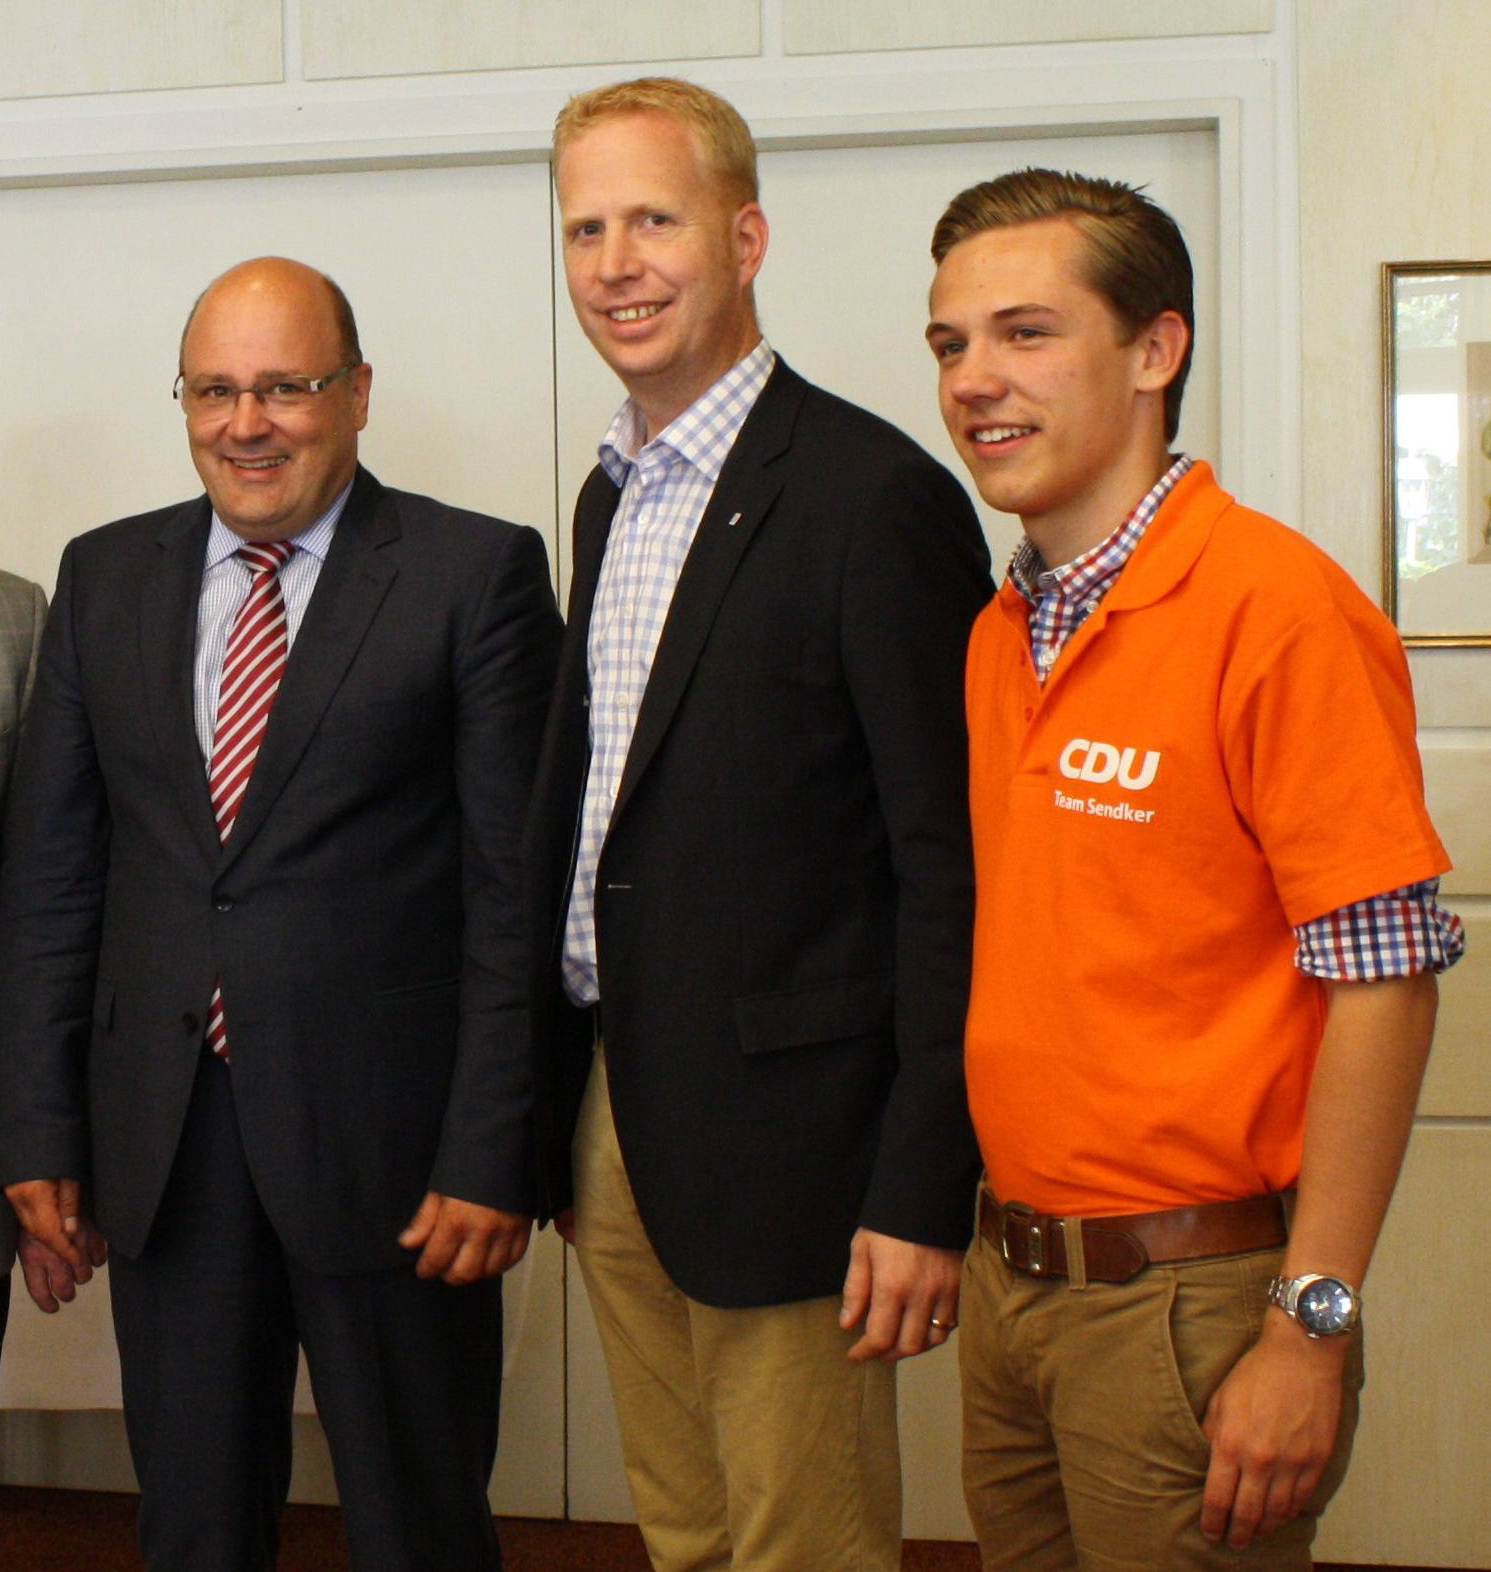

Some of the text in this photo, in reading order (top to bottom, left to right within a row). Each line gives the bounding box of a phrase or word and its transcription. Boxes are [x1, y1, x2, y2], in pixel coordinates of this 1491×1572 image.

[1059, 738, 1161, 791] CDU
[1054, 790, 1155, 823] Team Sendker
